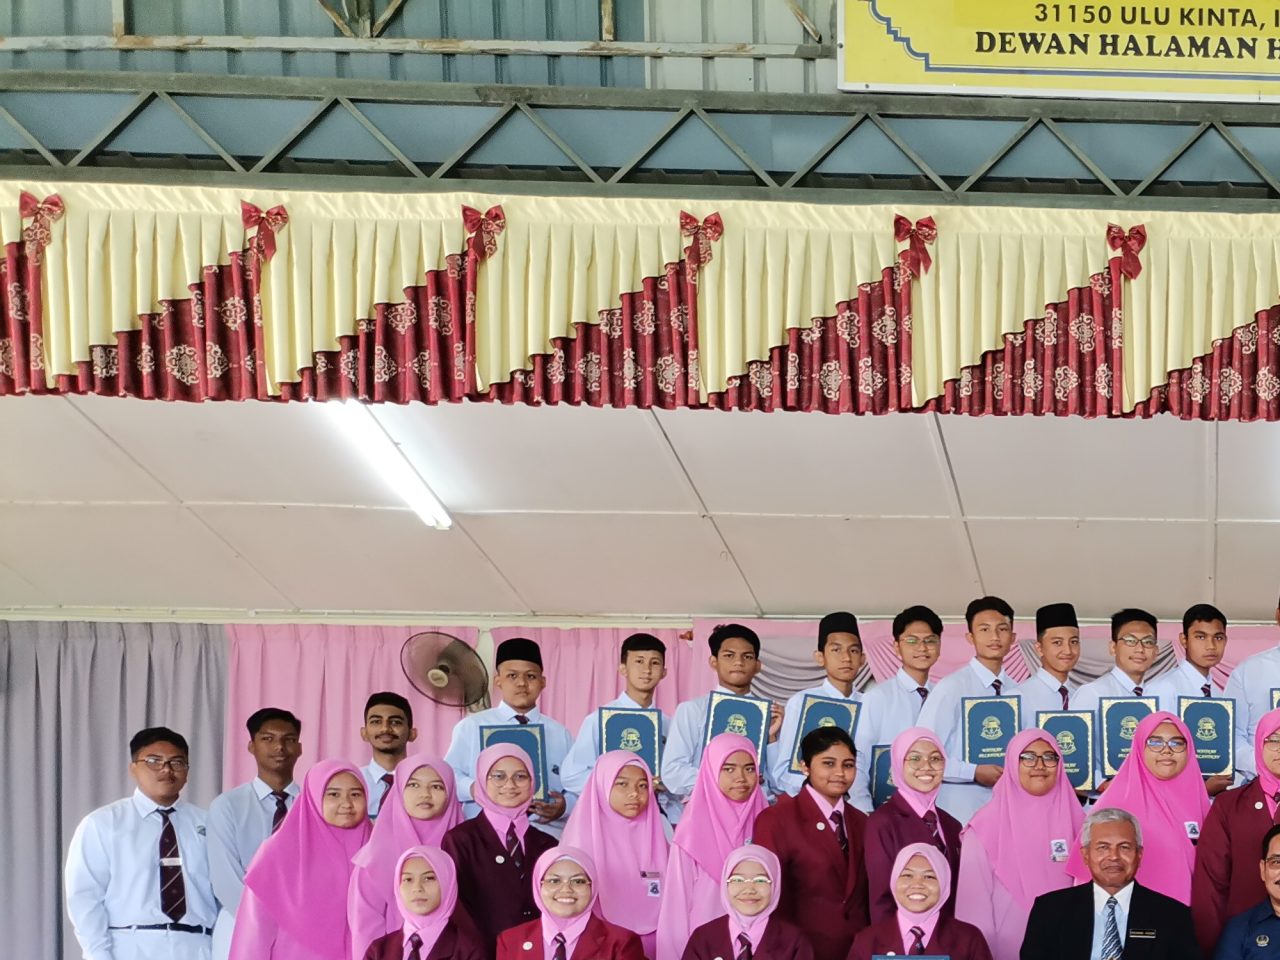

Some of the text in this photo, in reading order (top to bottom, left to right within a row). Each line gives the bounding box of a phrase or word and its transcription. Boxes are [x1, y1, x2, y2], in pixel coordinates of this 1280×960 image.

[1034, 3, 1112, 25] 31150
[1120, 5, 1171, 26] ULU
[1180, 7, 1265, 31] KINTA,
[975, 31, 1090, 56] DEWAN
[1099, 33, 1258, 60] HALAMAN
